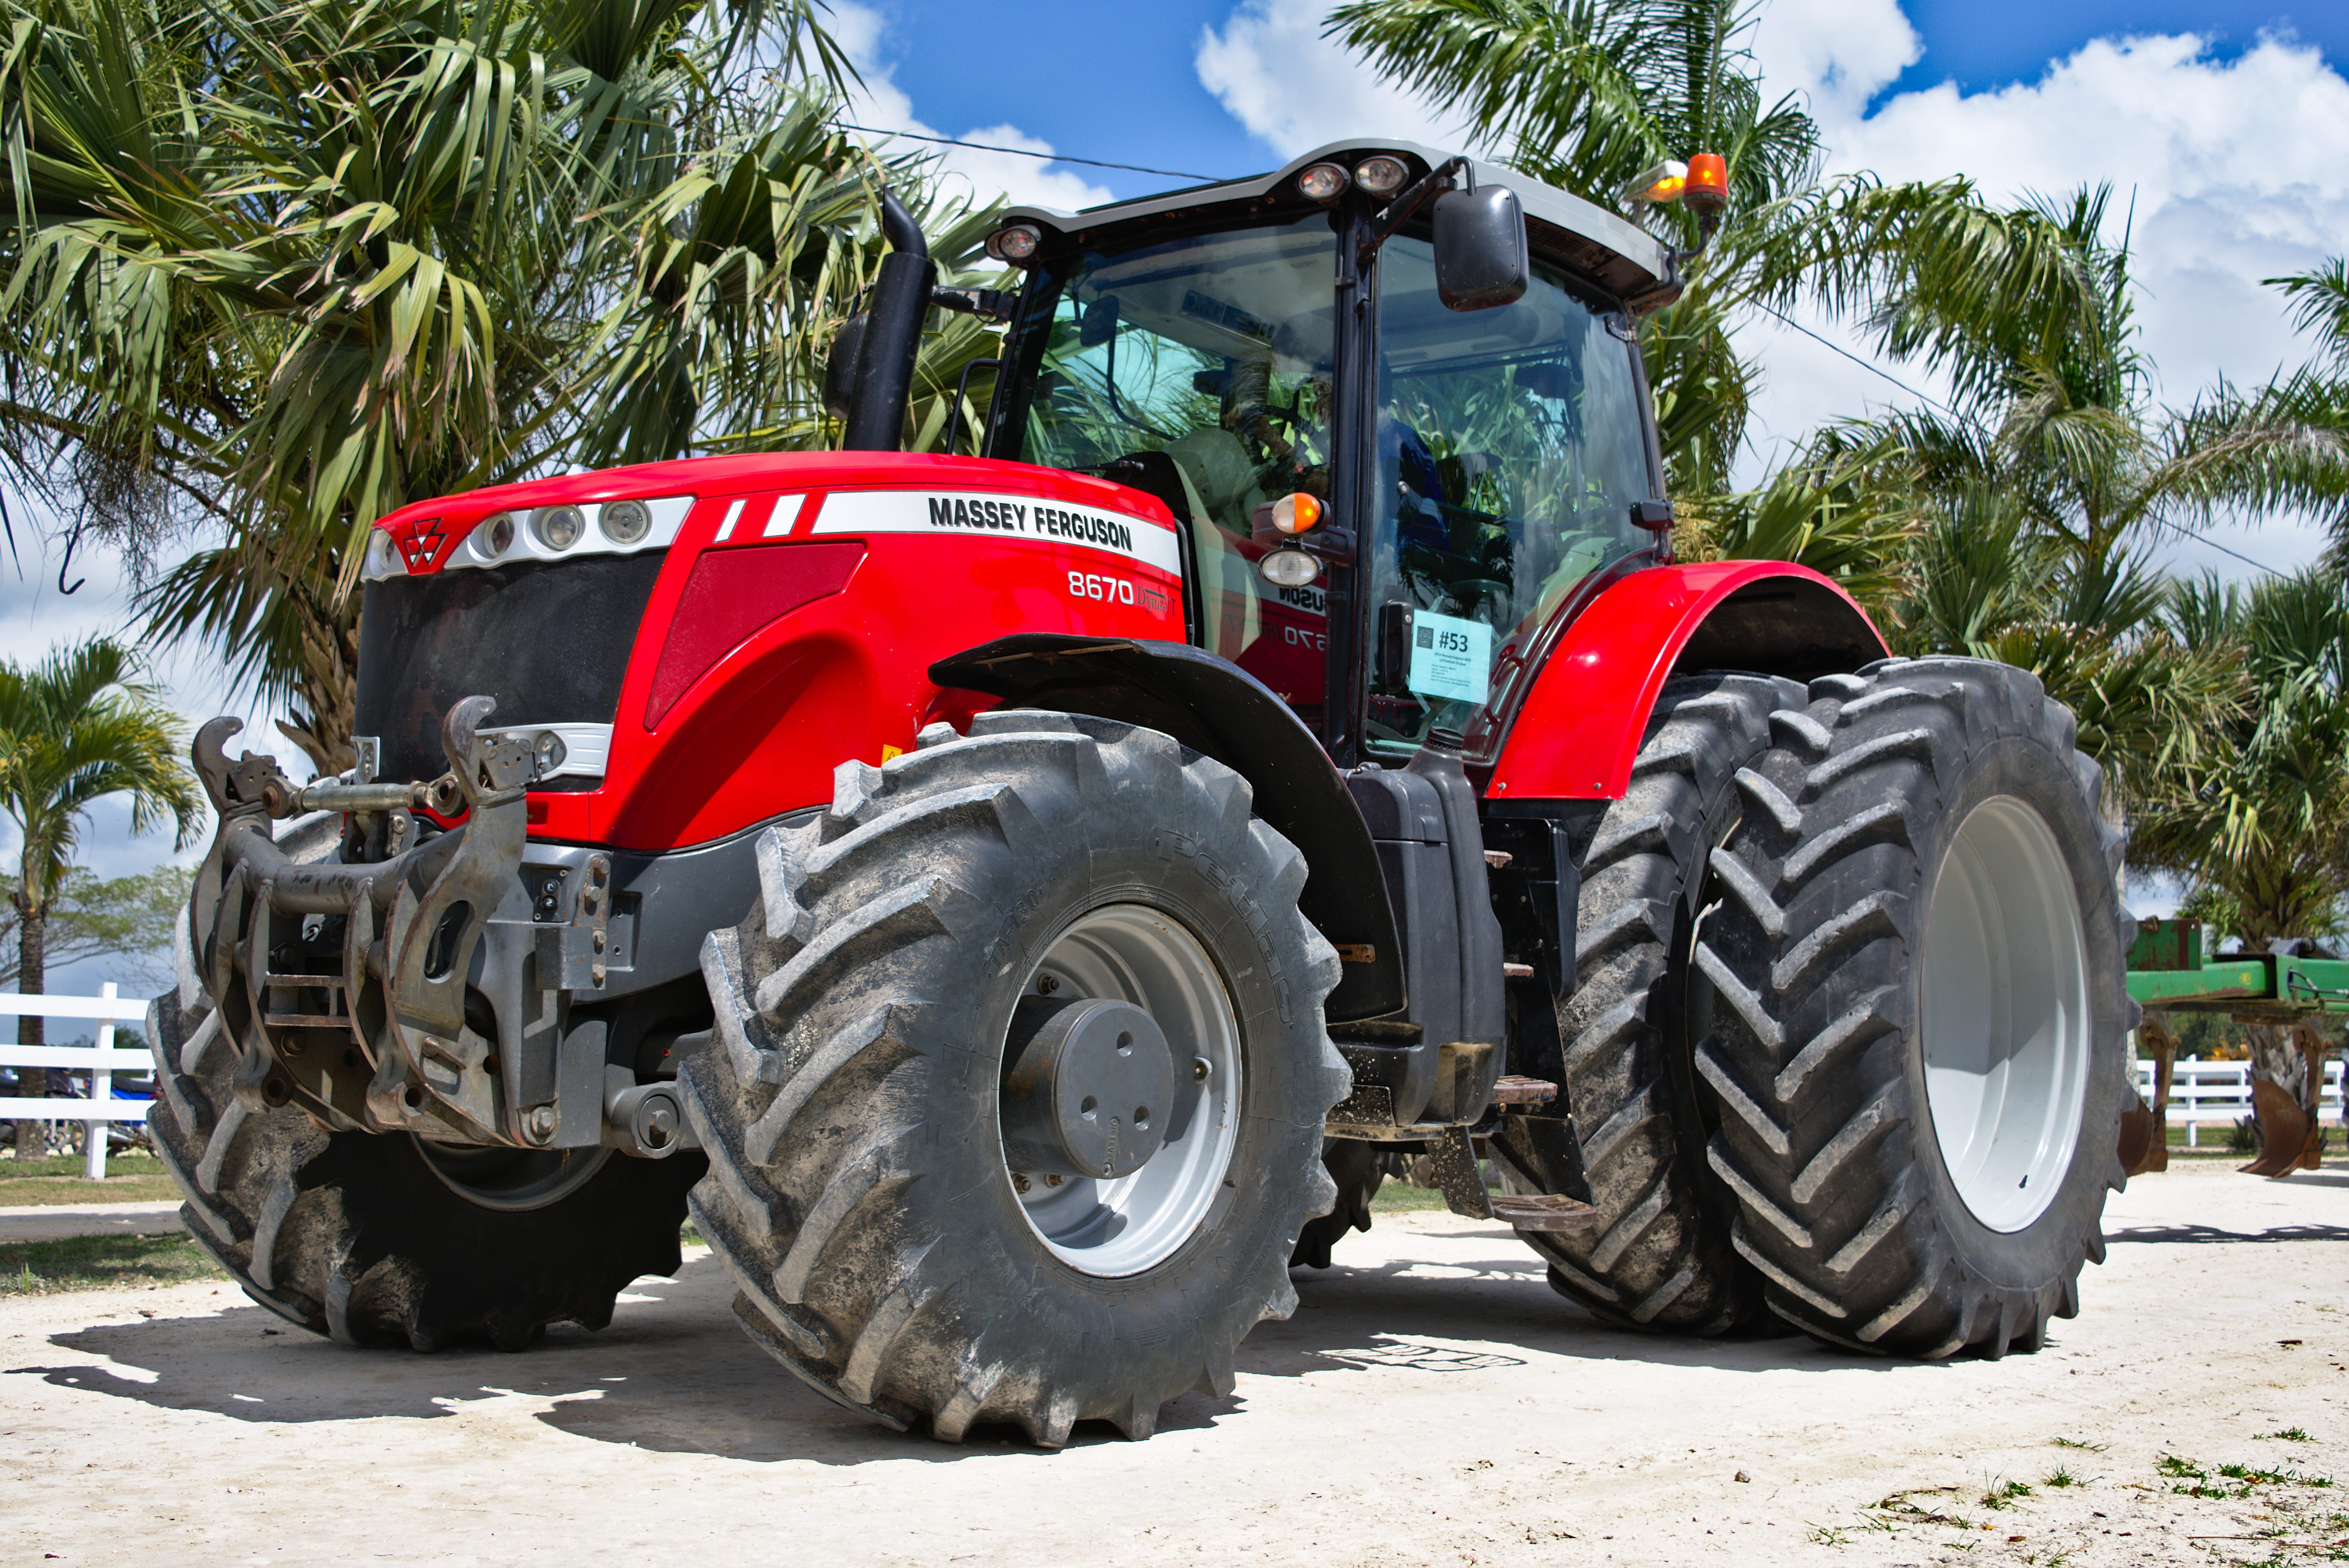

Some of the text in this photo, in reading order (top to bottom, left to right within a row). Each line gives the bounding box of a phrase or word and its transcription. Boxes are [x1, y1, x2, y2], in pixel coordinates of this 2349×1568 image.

[929, 497, 1133, 552] MASSEY FERGUSON
[1068, 571, 1176, 617] 8670 Dyna-VT
[1439, 631, 1467, 652] #53
[986, 889, 1039, 969] TA-130
[1158, 829, 1294, 1024] Petlas
